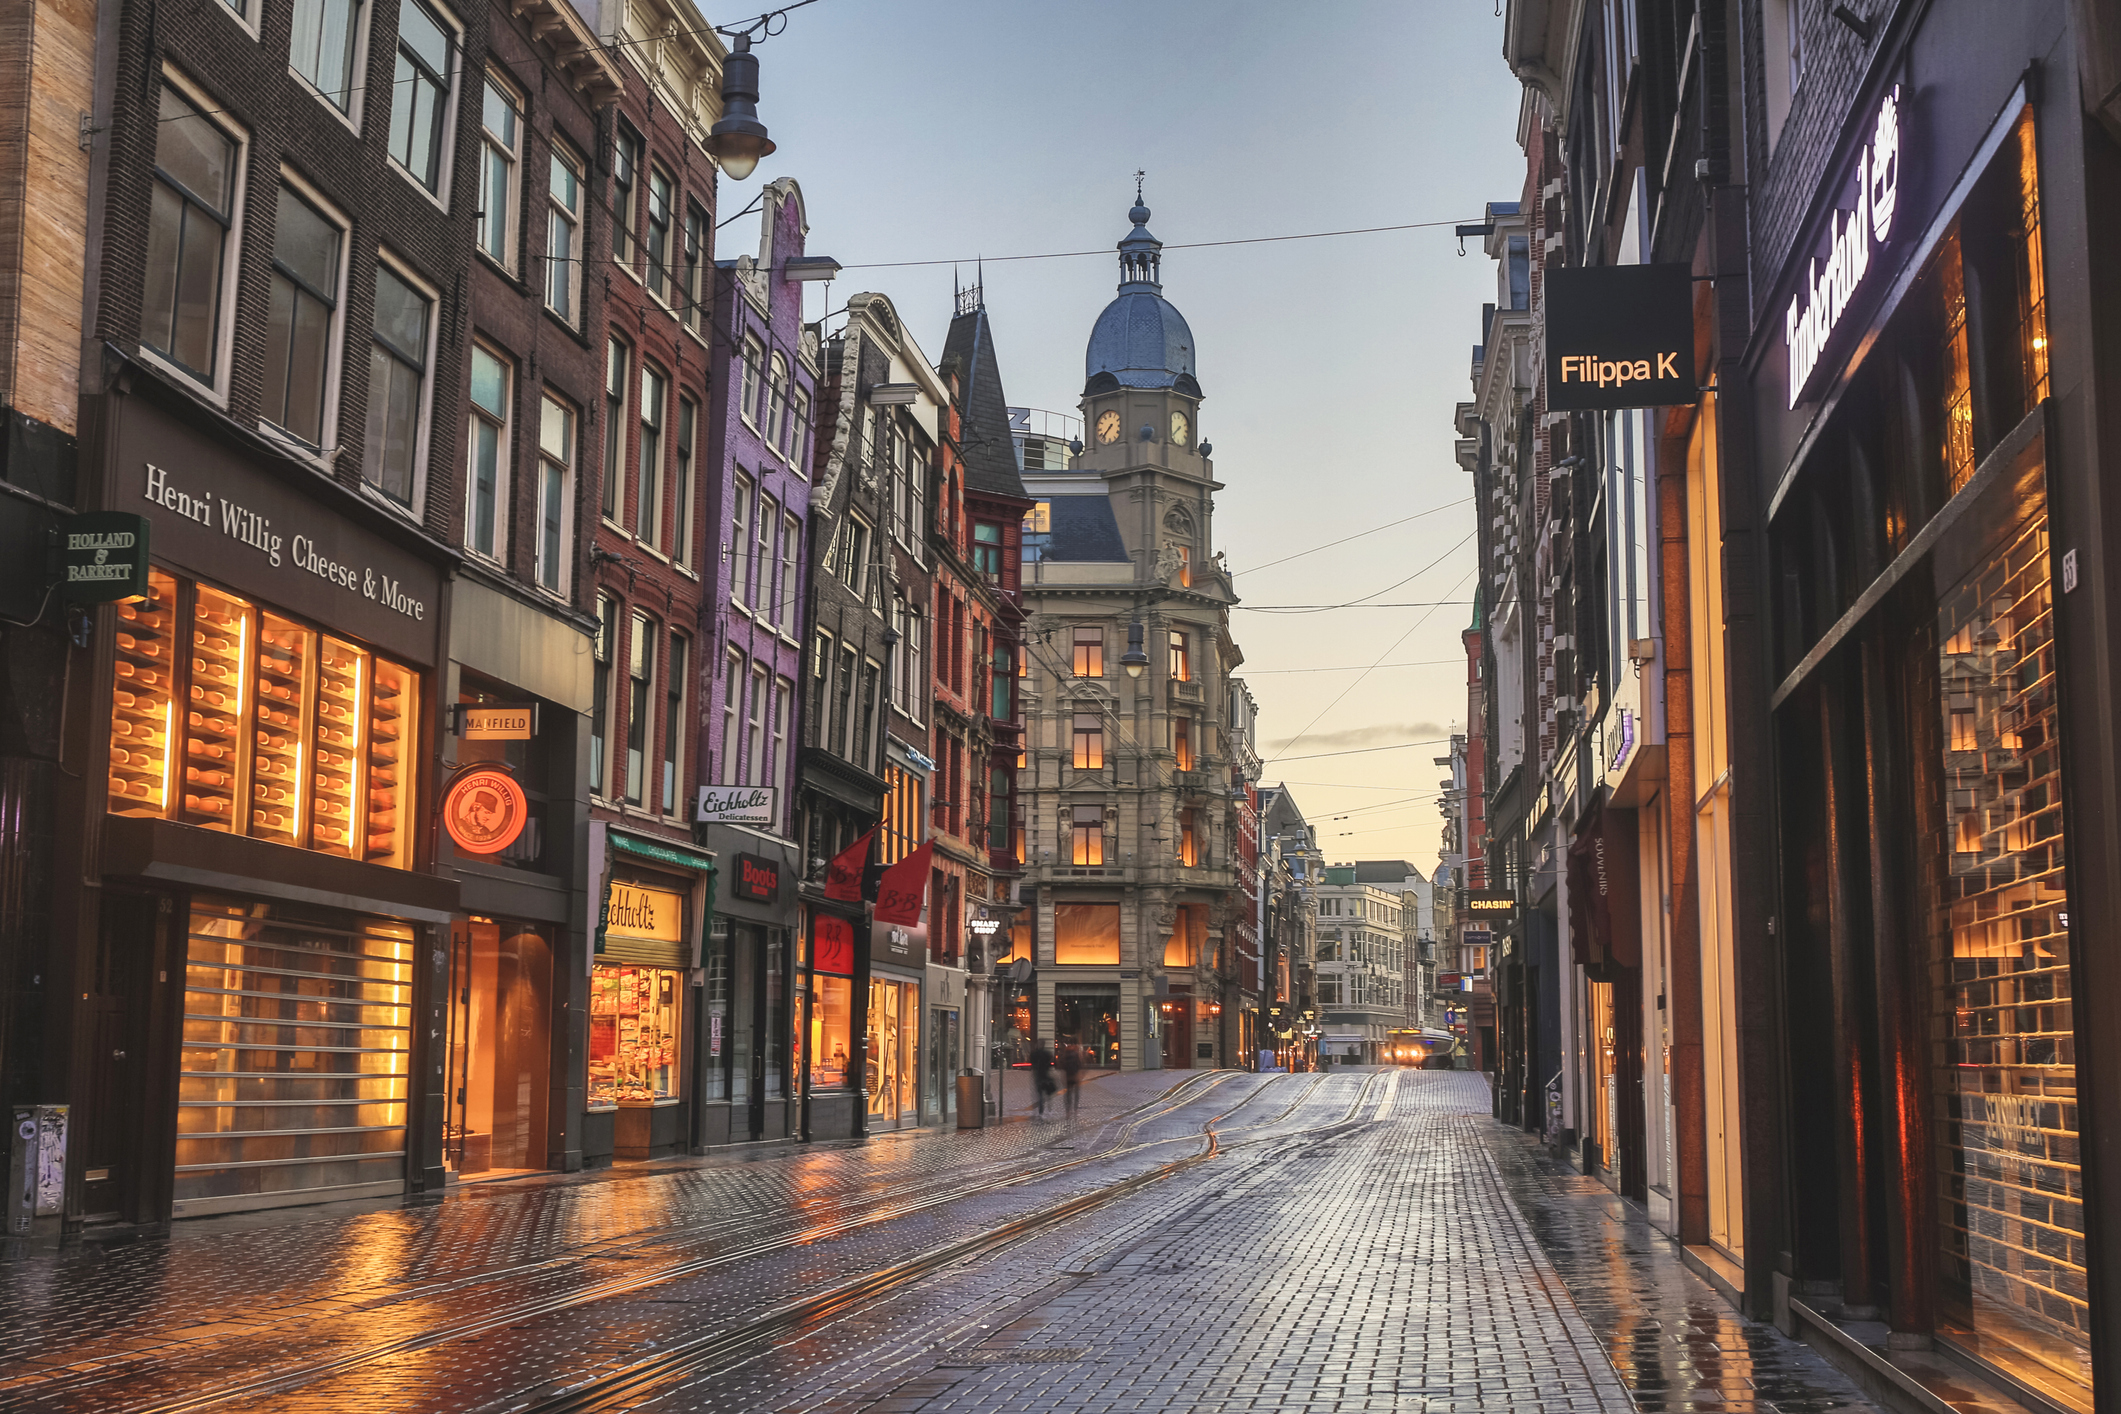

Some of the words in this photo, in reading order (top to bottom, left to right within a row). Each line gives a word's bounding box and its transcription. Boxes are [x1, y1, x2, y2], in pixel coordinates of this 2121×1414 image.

[1786, 144, 1869, 411] Timberland
[1561, 355, 1651, 388] Filippa
[1657, 352, 1679, 379] K
[67, 532, 135, 550] HOLLAND
[144, 463, 211, 527] Henri
[220, 498, 282, 567] Willig
[292, 534, 357, 591] Cheese
[362, 567, 377, 600] &
[380, 574, 424, 621] More
[94, 549, 109, 565] &
[67, 564, 132, 581] BARRETT
[466, 718, 526, 730] MANFIELD
[460, 778, 489, 795] HENRI
[490, 780, 513, 807] WILLIG
[703, 790, 769, 813] Eichholtz
[718, 813, 768, 821] Delicatessen
[743, 860, 777, 889] Boots
[1470, 900, 1514, 909] CHASIN'
